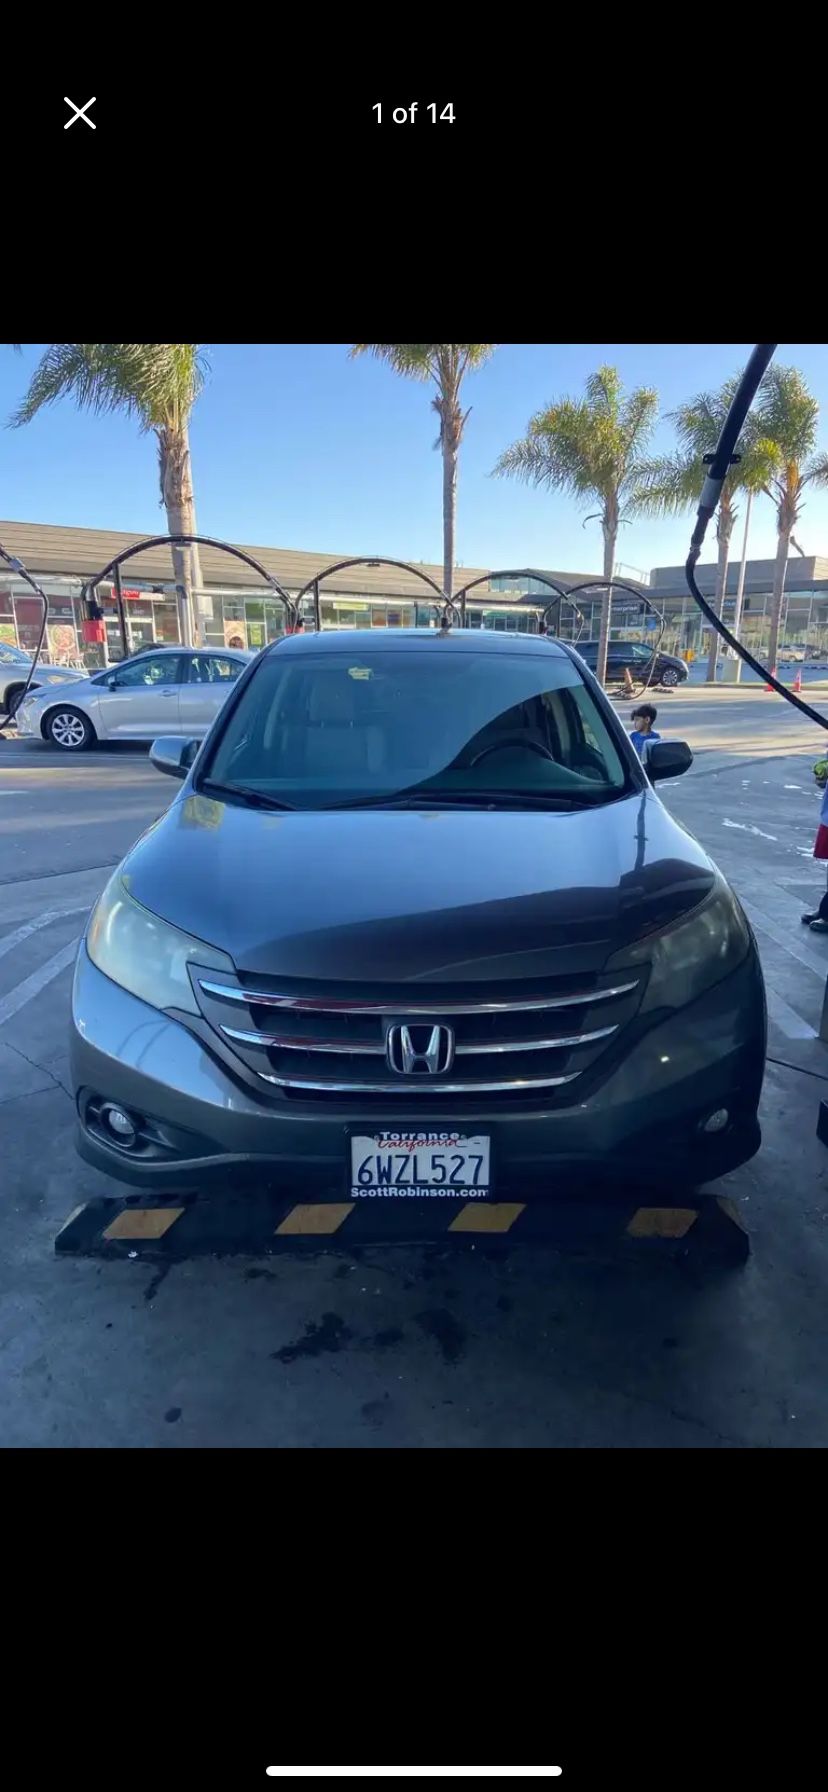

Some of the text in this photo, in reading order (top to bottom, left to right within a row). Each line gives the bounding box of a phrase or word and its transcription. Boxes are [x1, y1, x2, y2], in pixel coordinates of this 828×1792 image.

[380, 1131, 460, 1141] Torrance
[357, 1154, 484, 1185] 6WZL527
[351, 1186, 488, 1198] ScottRobinson.com
